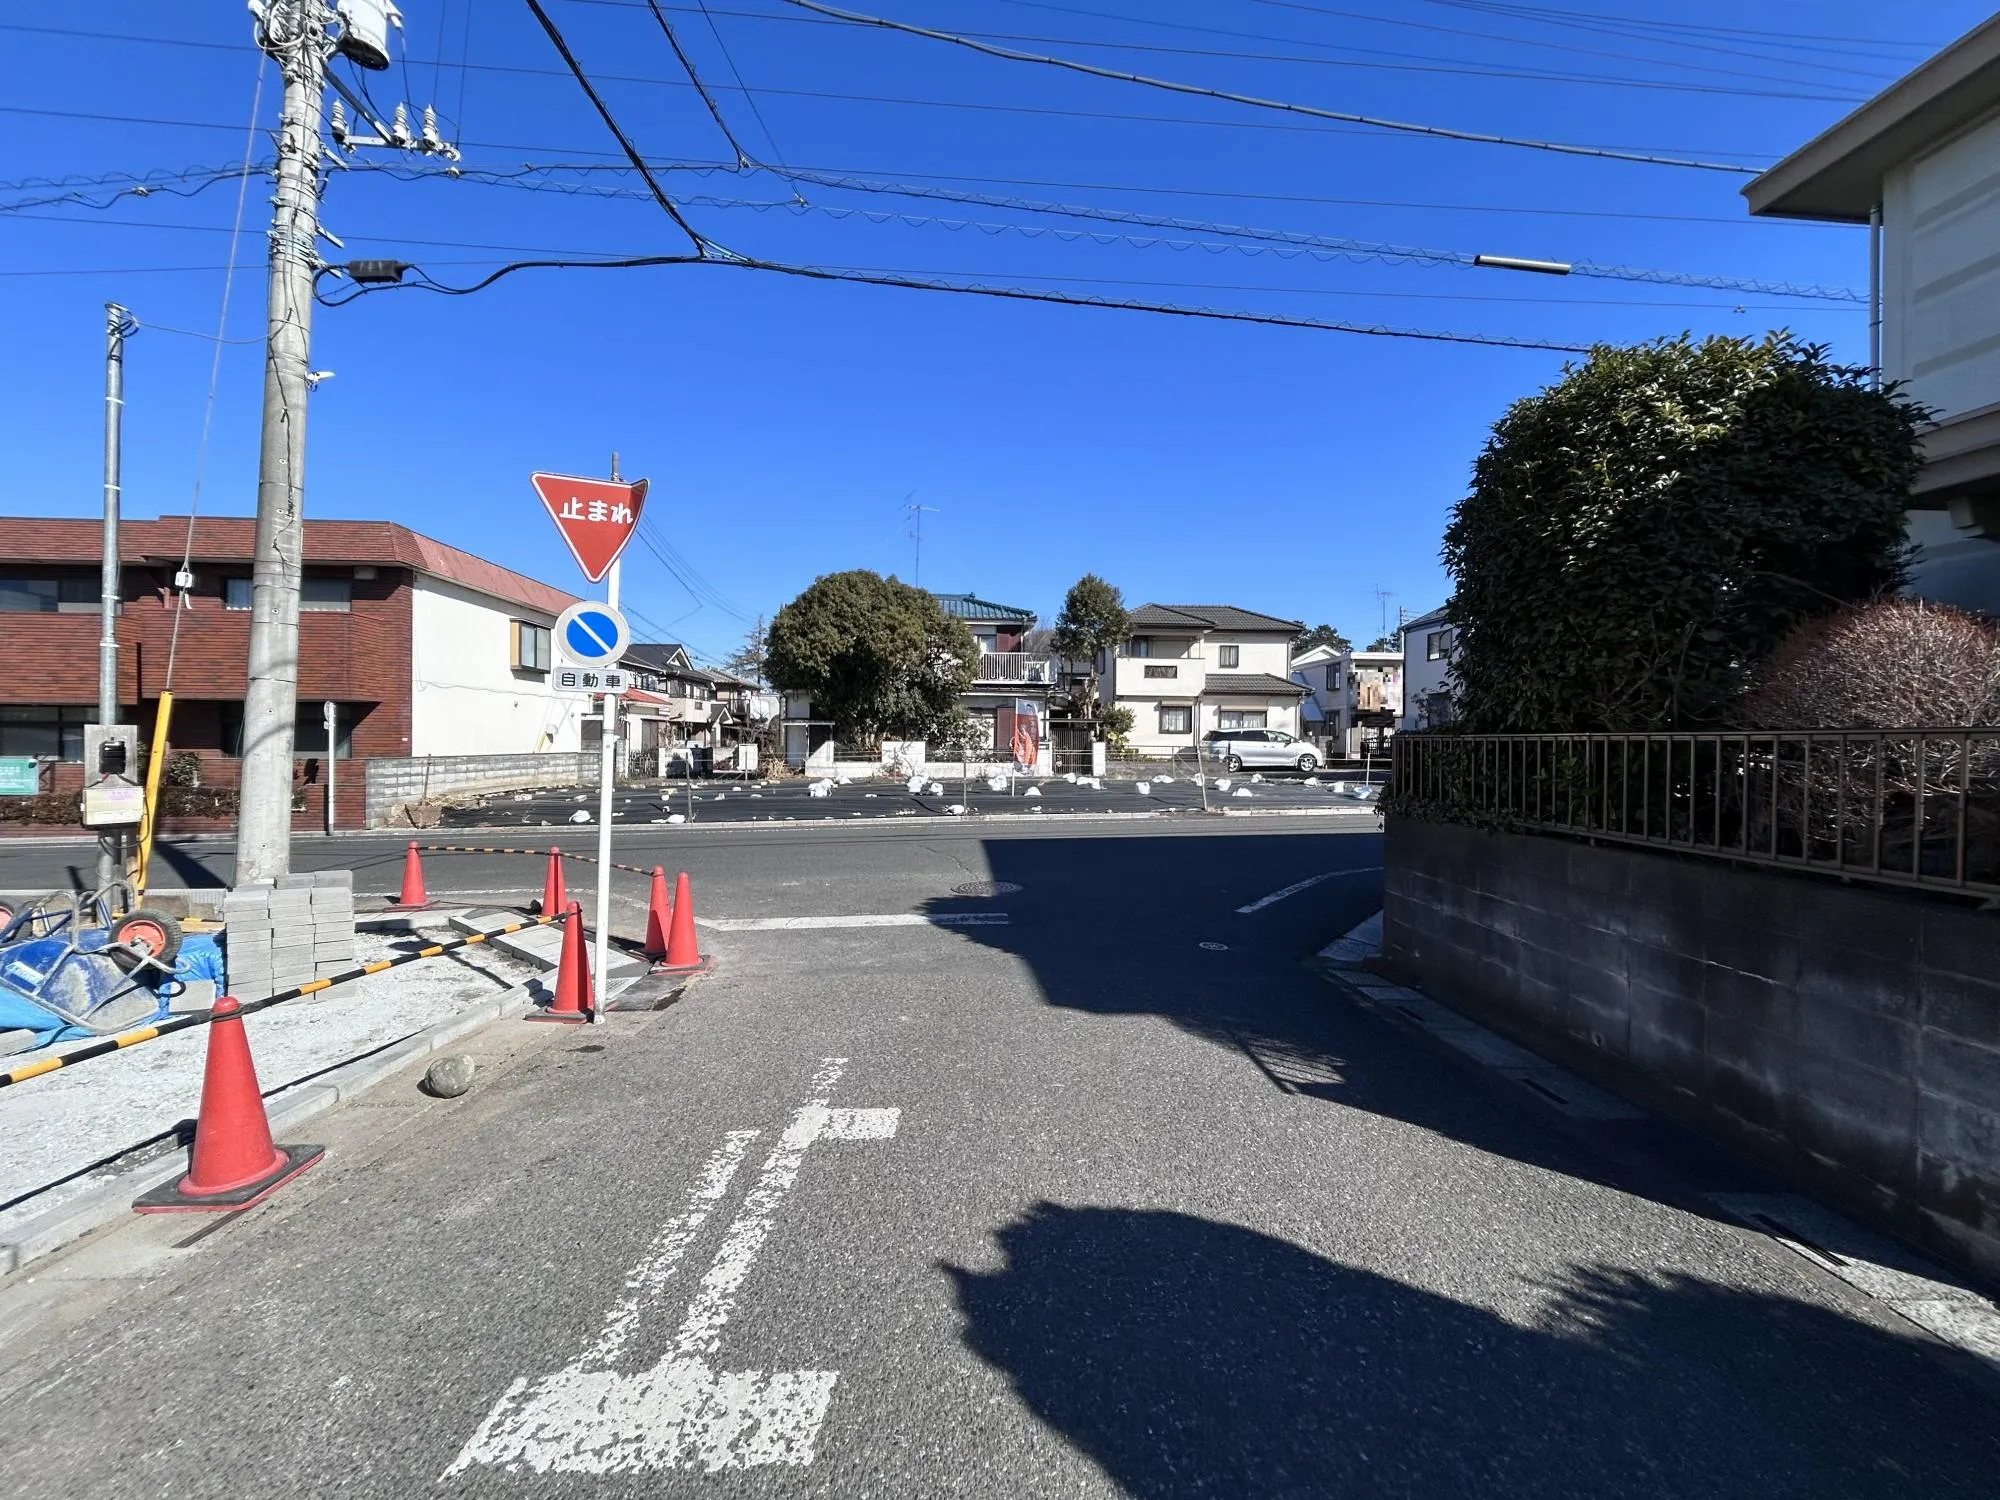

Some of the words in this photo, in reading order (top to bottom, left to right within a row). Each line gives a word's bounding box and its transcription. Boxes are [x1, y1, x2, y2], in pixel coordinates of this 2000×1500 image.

[559, 496, 634, 525] 止まれ
[561, 671, 622, 689] 自動車
